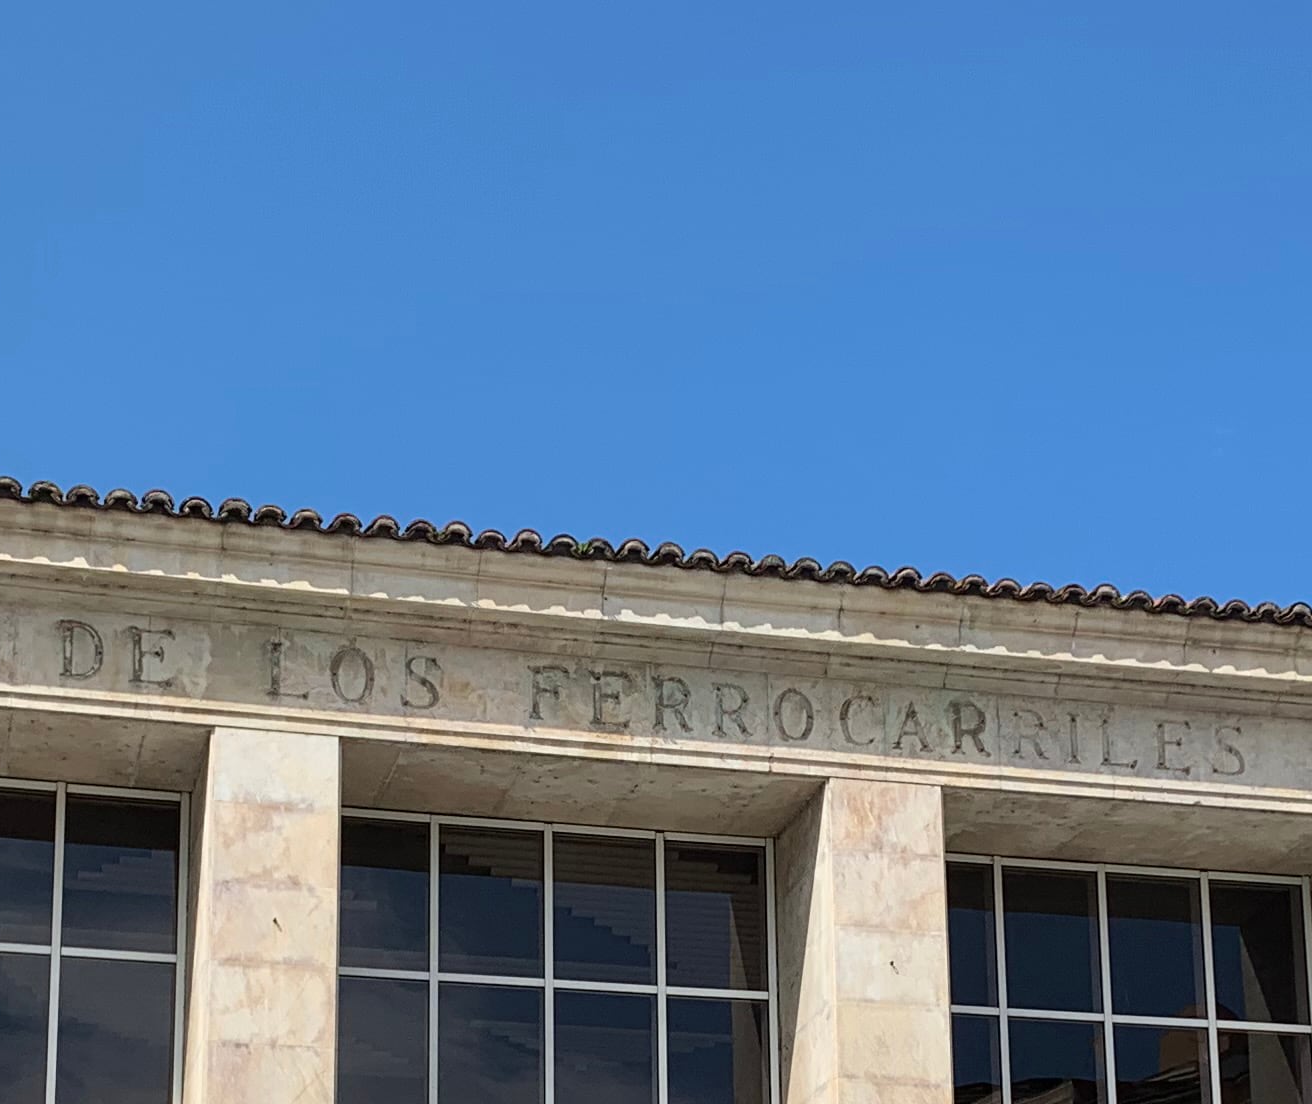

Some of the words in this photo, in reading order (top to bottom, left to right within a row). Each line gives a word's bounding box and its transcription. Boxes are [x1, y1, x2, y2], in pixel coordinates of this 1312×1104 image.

[57, 617, 178, 690] DE
[265, 638, 443, 712] LOS
[526, 663, 1248, 777] FERROCARRILES
